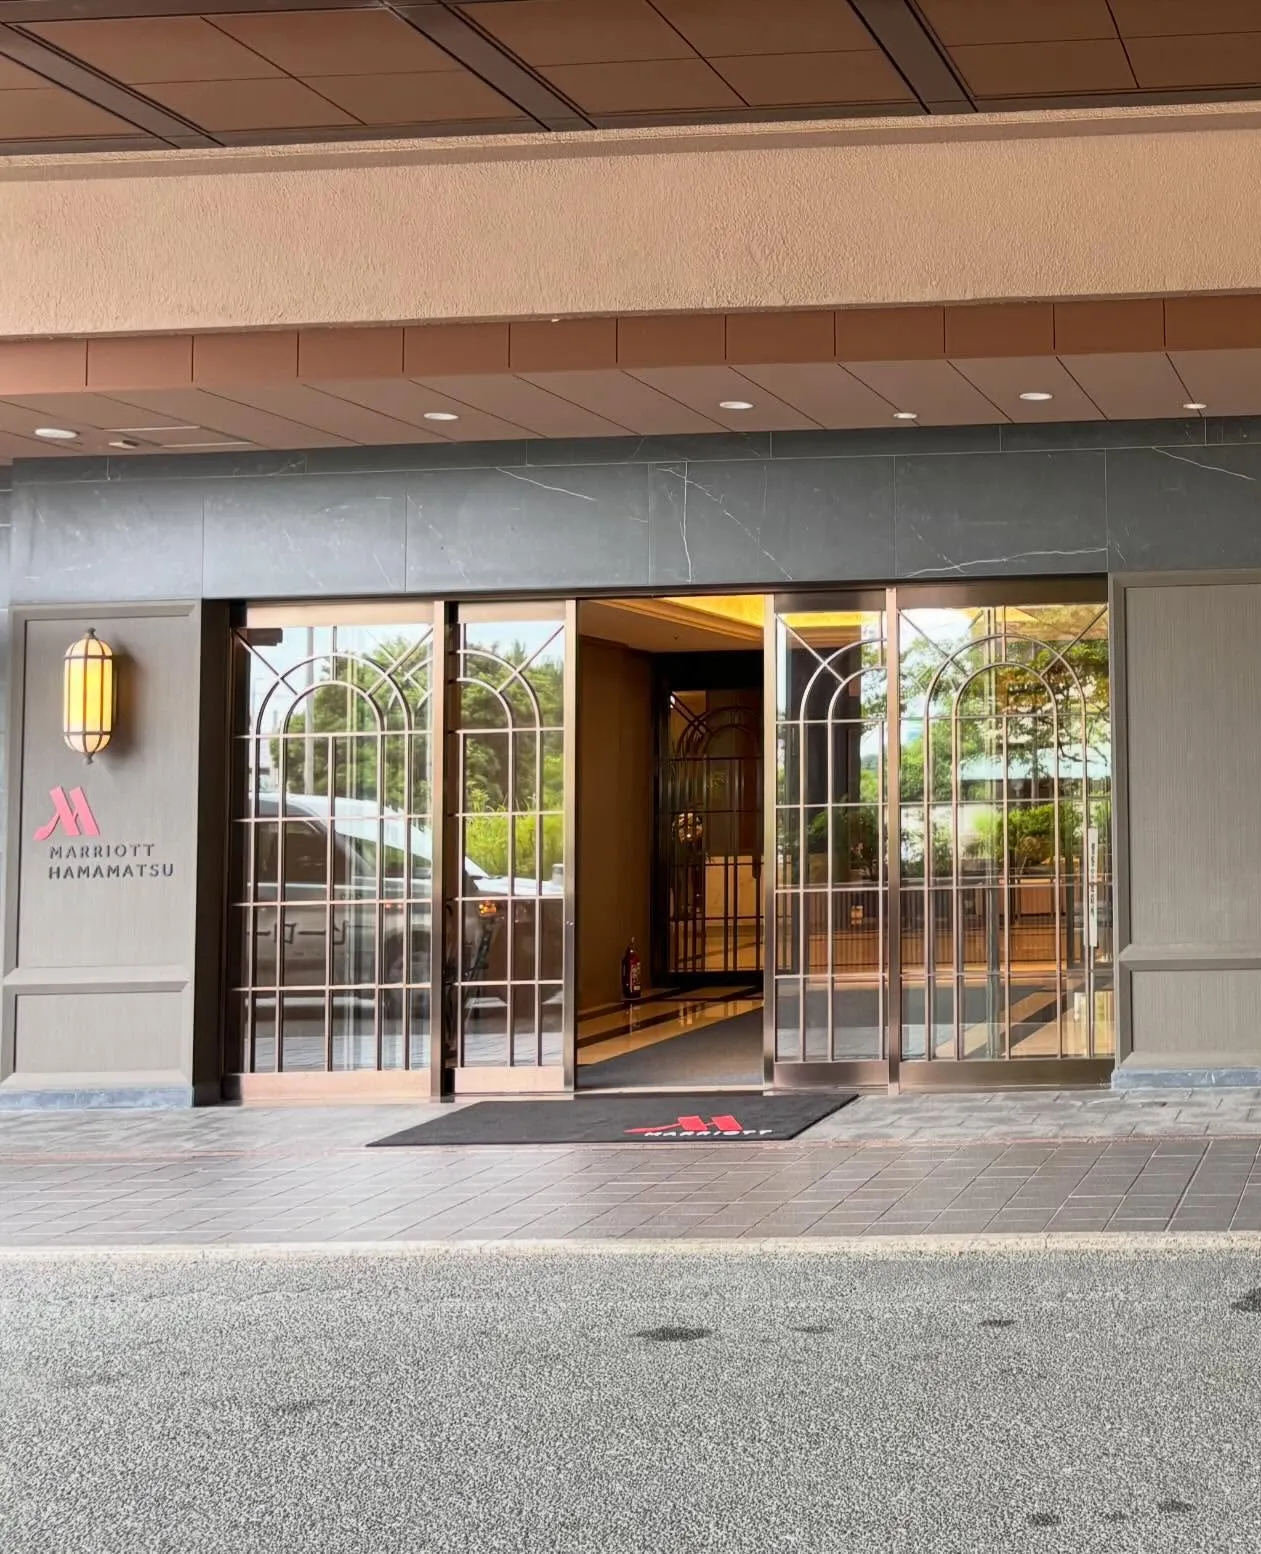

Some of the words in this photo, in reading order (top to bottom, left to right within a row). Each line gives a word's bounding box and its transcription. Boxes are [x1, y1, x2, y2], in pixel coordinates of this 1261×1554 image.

[50, 844, 155, 859] MARRIOTT
[49, 864, 174, 880] HAMAMATSU
[644, 1129, 773, 1137] MARRIOTT
